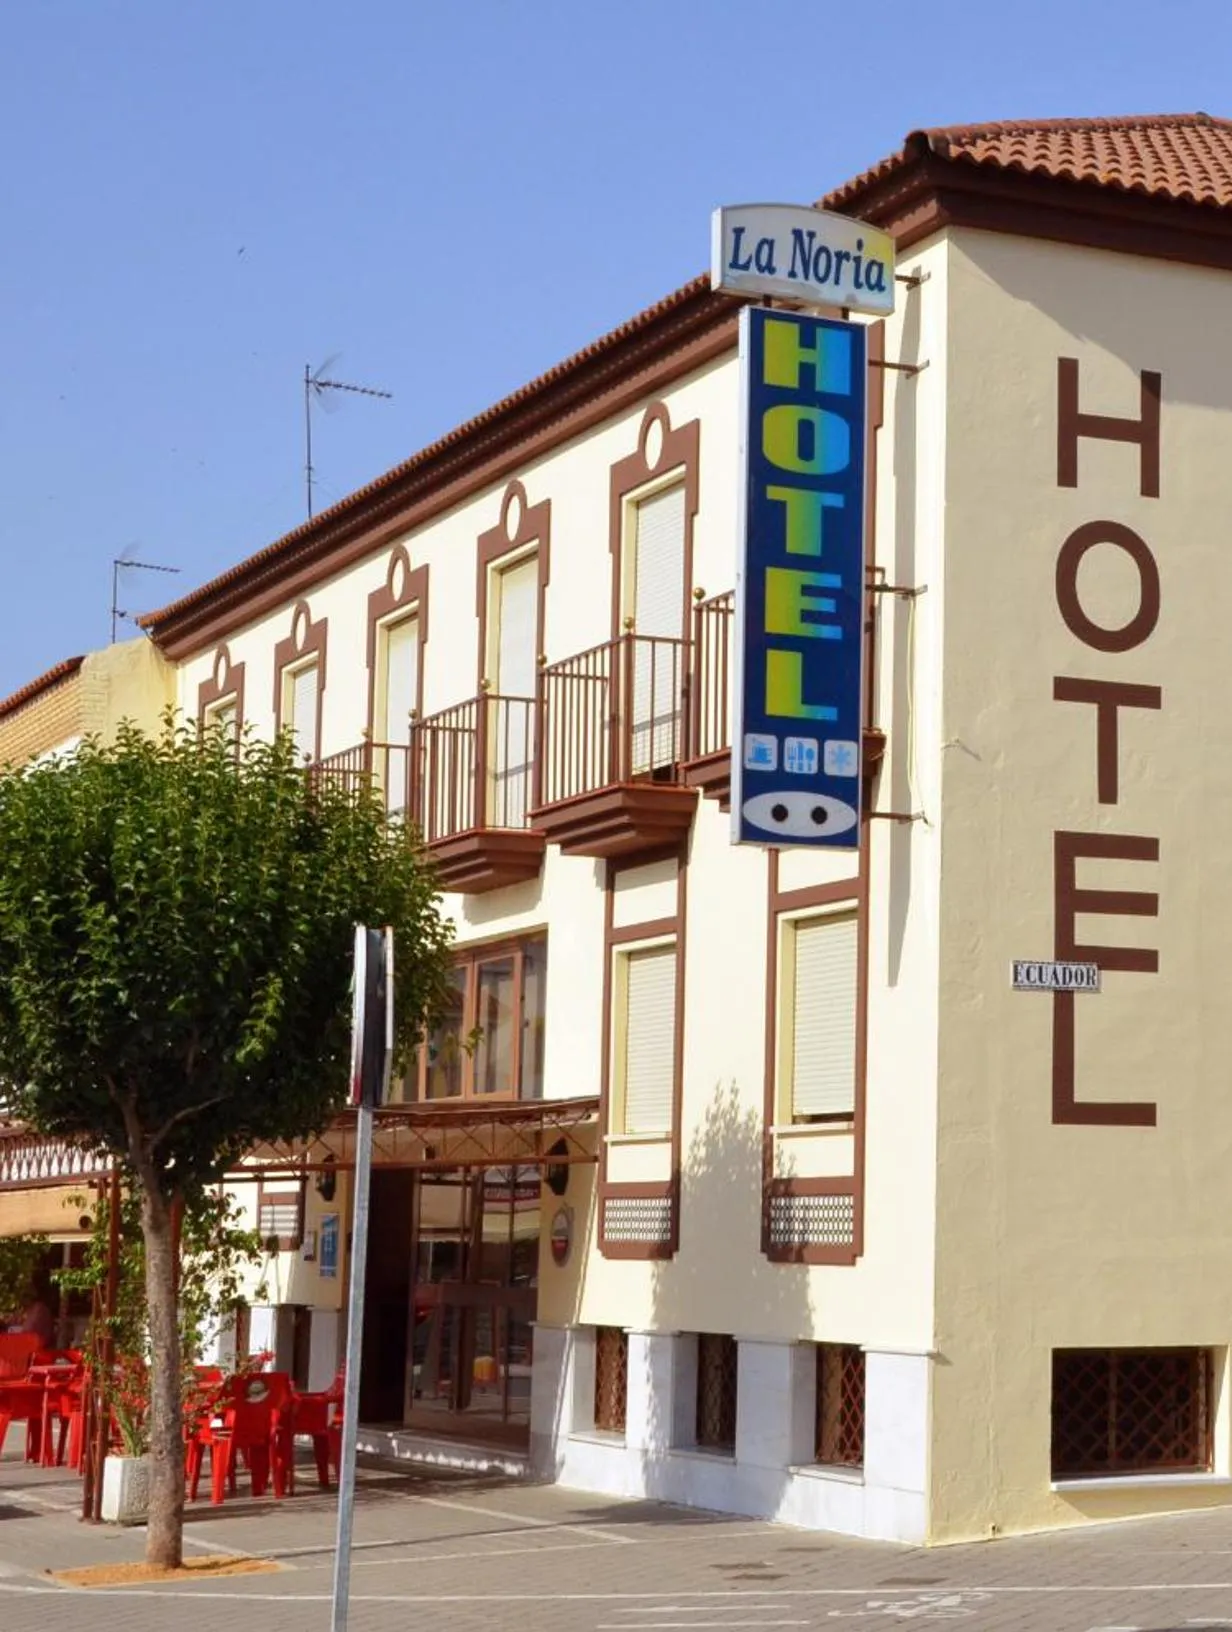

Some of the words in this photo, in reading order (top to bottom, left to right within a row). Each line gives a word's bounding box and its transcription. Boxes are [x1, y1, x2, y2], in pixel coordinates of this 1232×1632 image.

[729, 227, 776, 275] La
[788, 228, 886, 292] Noria
[762, 318, 853, 722] HOTEL
[1053, 356, 1161, 1126] HOTEL
[1013, 963, 1096, 986] ECUADOR
